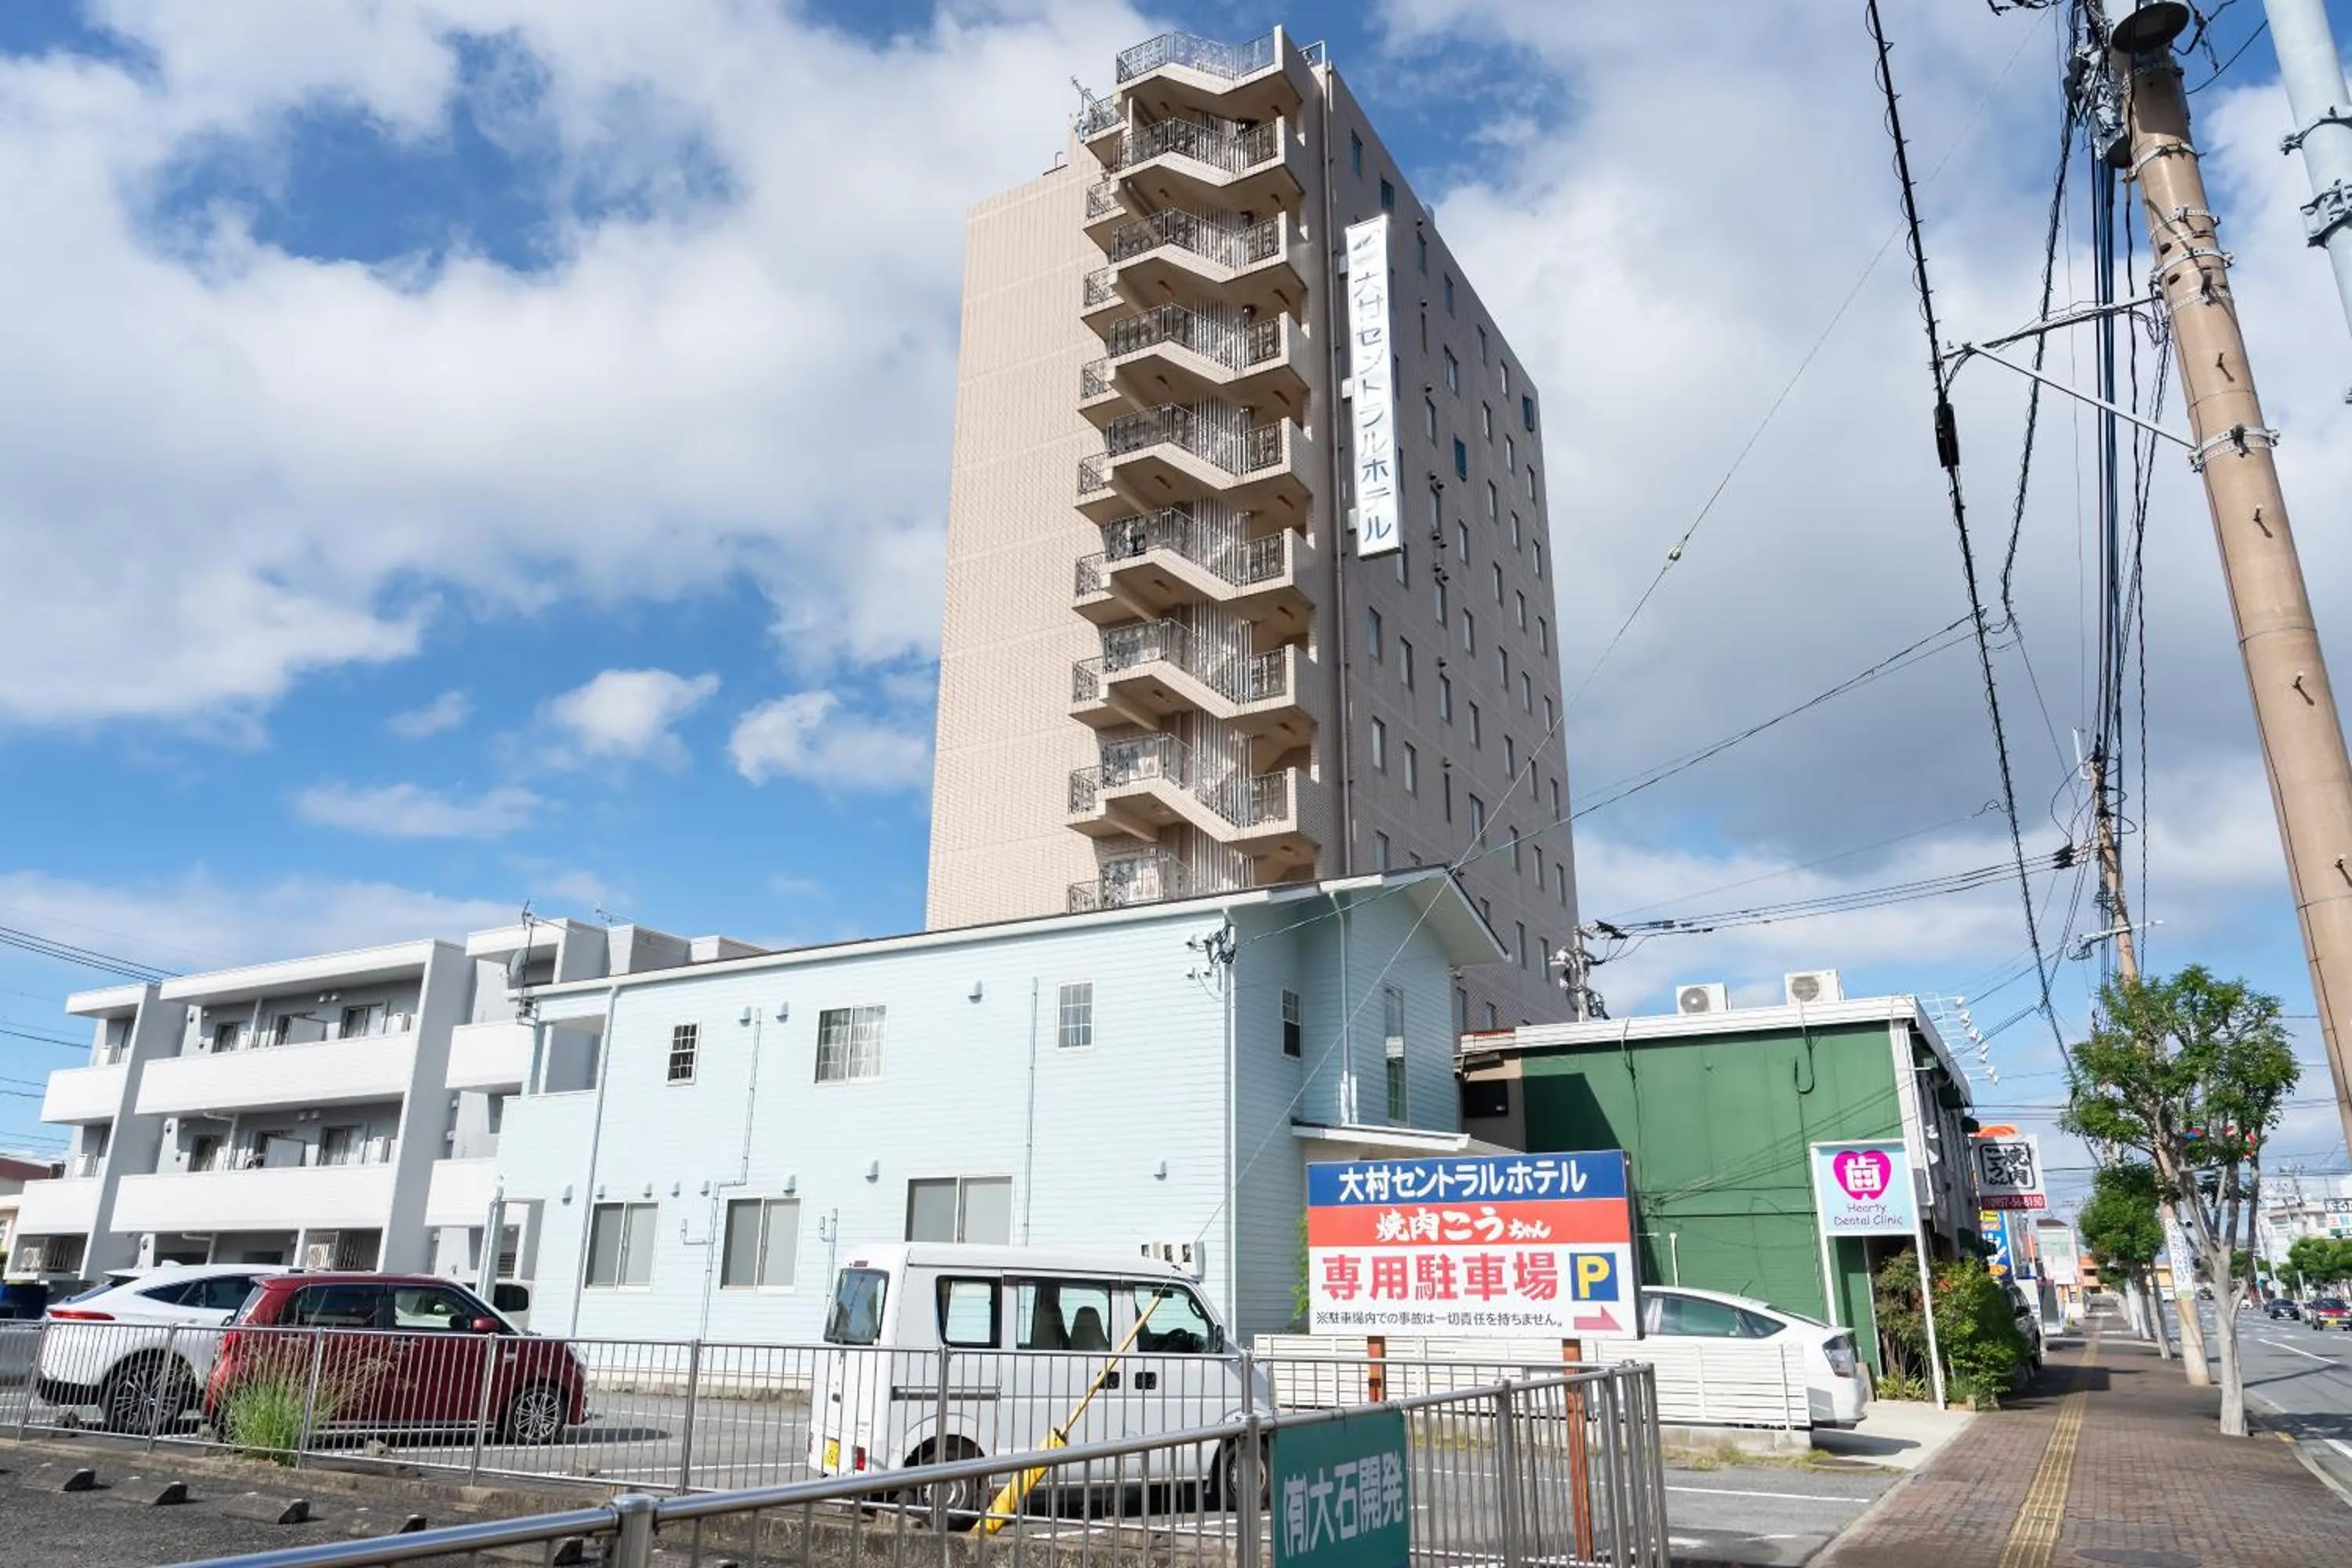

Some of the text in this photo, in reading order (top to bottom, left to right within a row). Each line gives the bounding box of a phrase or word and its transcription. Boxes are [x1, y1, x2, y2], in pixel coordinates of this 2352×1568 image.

[1338, 1159, 1588, 1202] 大村セントラルホテル
[1375, 1206, 1552, 1243] 焼肉こうちゃん
[1834, 1214, 1903, 1226] Dental Clinic
[1846, 1203, 1887, 1214] Hearty
[1320, 1252, 1559, 1302] 専用駐車場
[1577, 1255, 1610, 1299] P
